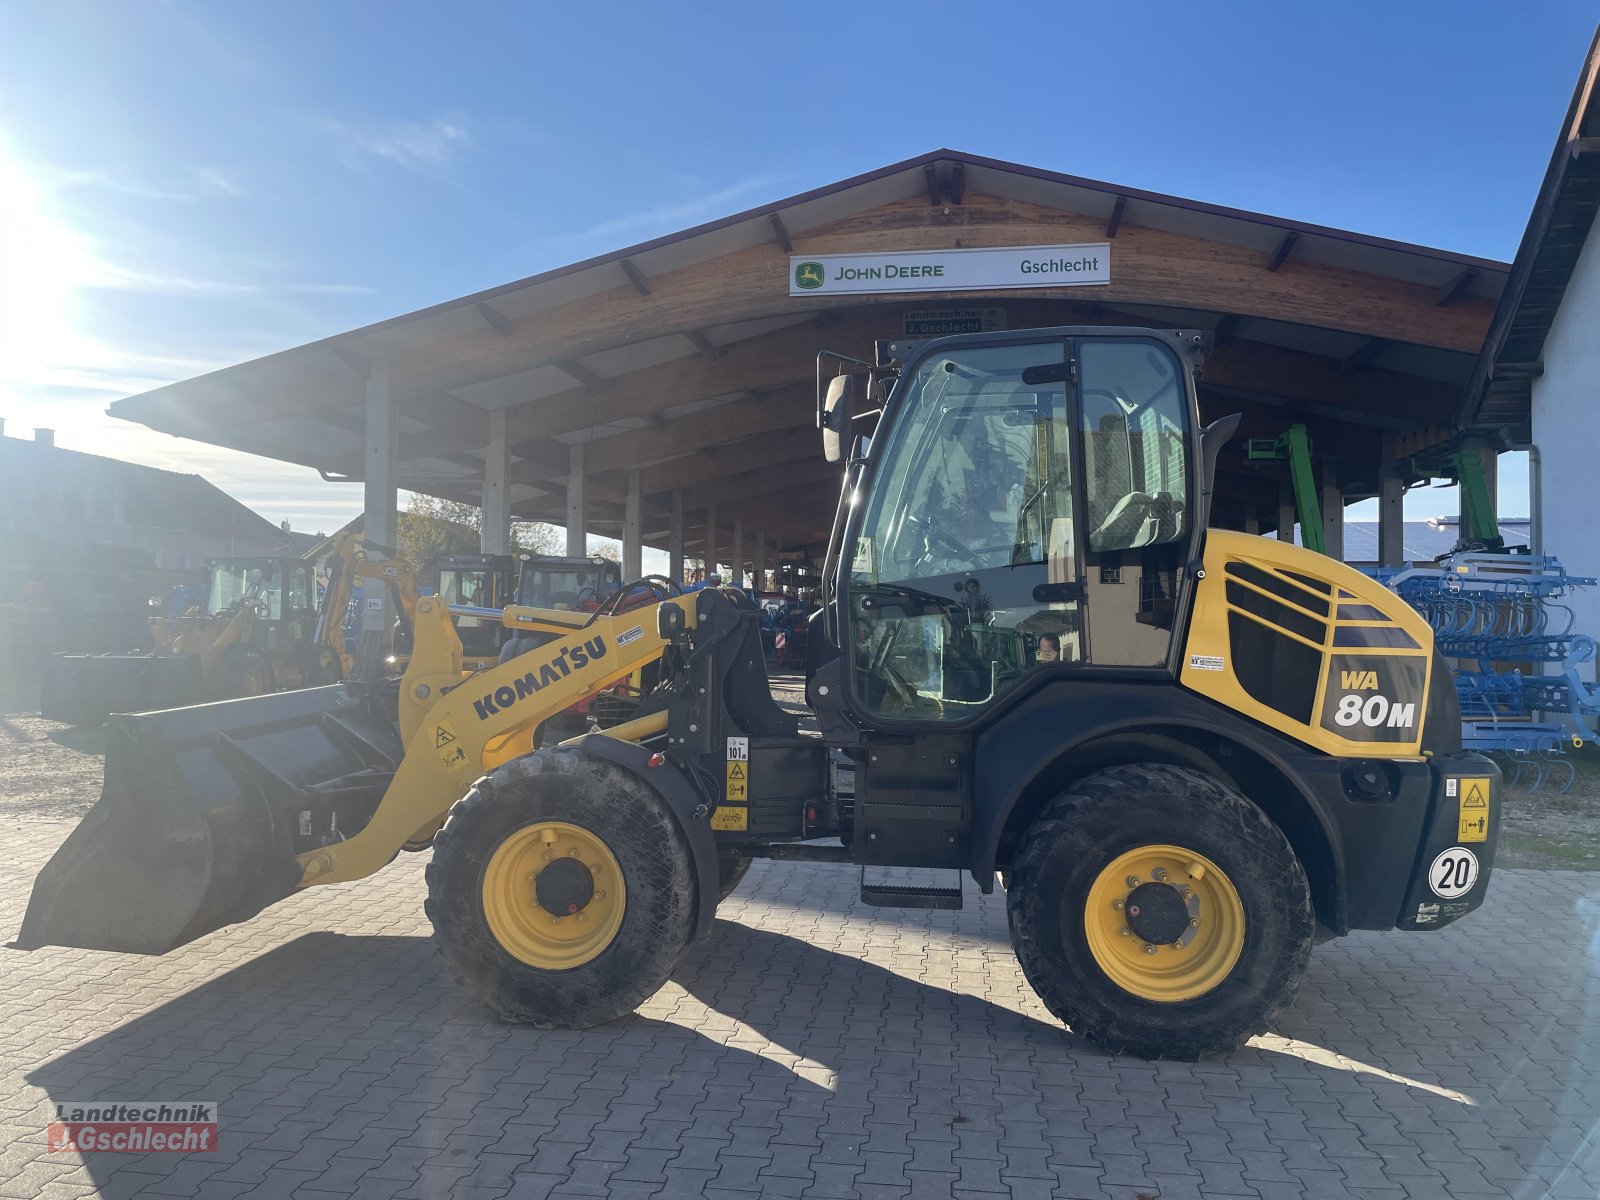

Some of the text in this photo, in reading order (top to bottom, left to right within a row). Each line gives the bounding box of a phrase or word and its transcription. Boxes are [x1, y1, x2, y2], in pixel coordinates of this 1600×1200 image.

[1020, 257, 1099, 274] Gschlecht
[905, 310, 983, 320] Landmaschinen
[921, 320, 979, 333] Gschlecht
[472, 635, 607, 721] KOMATSU
[1341, 670, 1379, 690] WA
[729, 747, 741, 759] 101
[1437, 857, 1471, 889] 20
